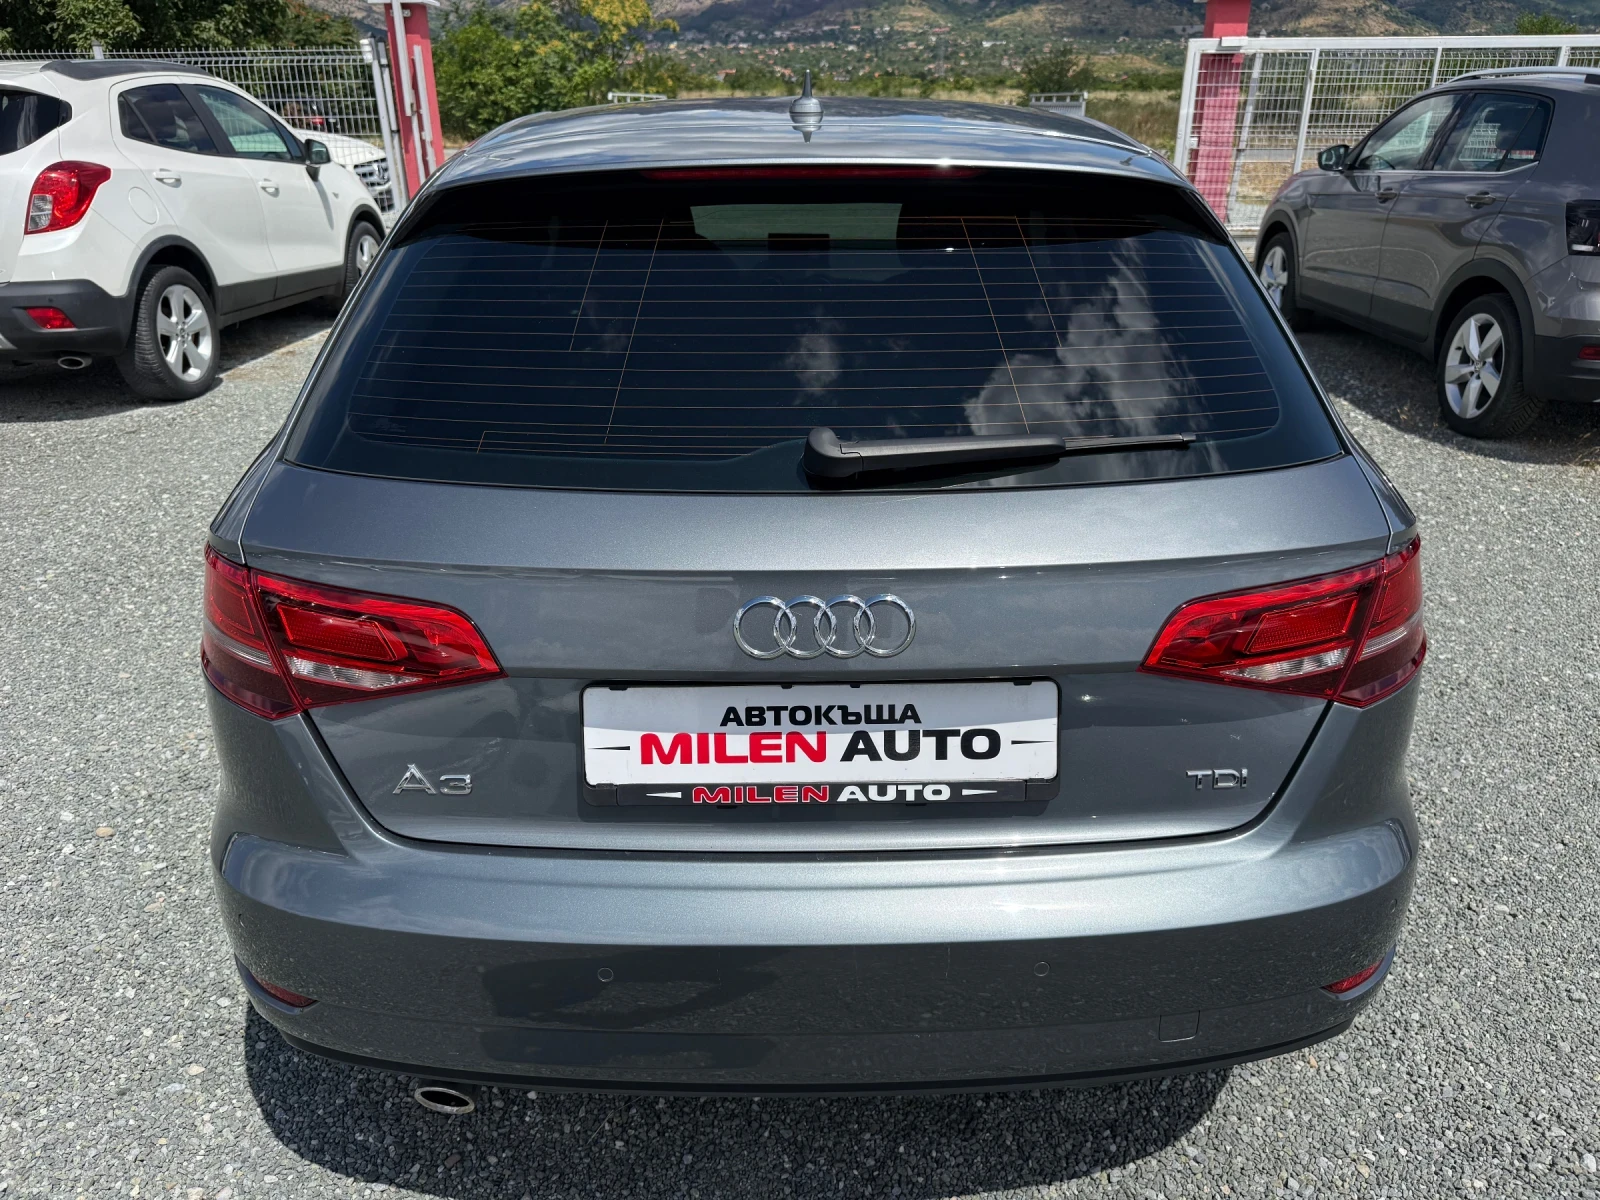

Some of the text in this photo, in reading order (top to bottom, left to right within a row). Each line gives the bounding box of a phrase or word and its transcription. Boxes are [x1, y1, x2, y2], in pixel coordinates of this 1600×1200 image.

[639, 728, 1002, 766] MILEN AUTO
[392, 763, 472, 795] A3
[1186, 768, 1248, 789] TDI
[692, 784, 951, 804] MILEN AUTO
